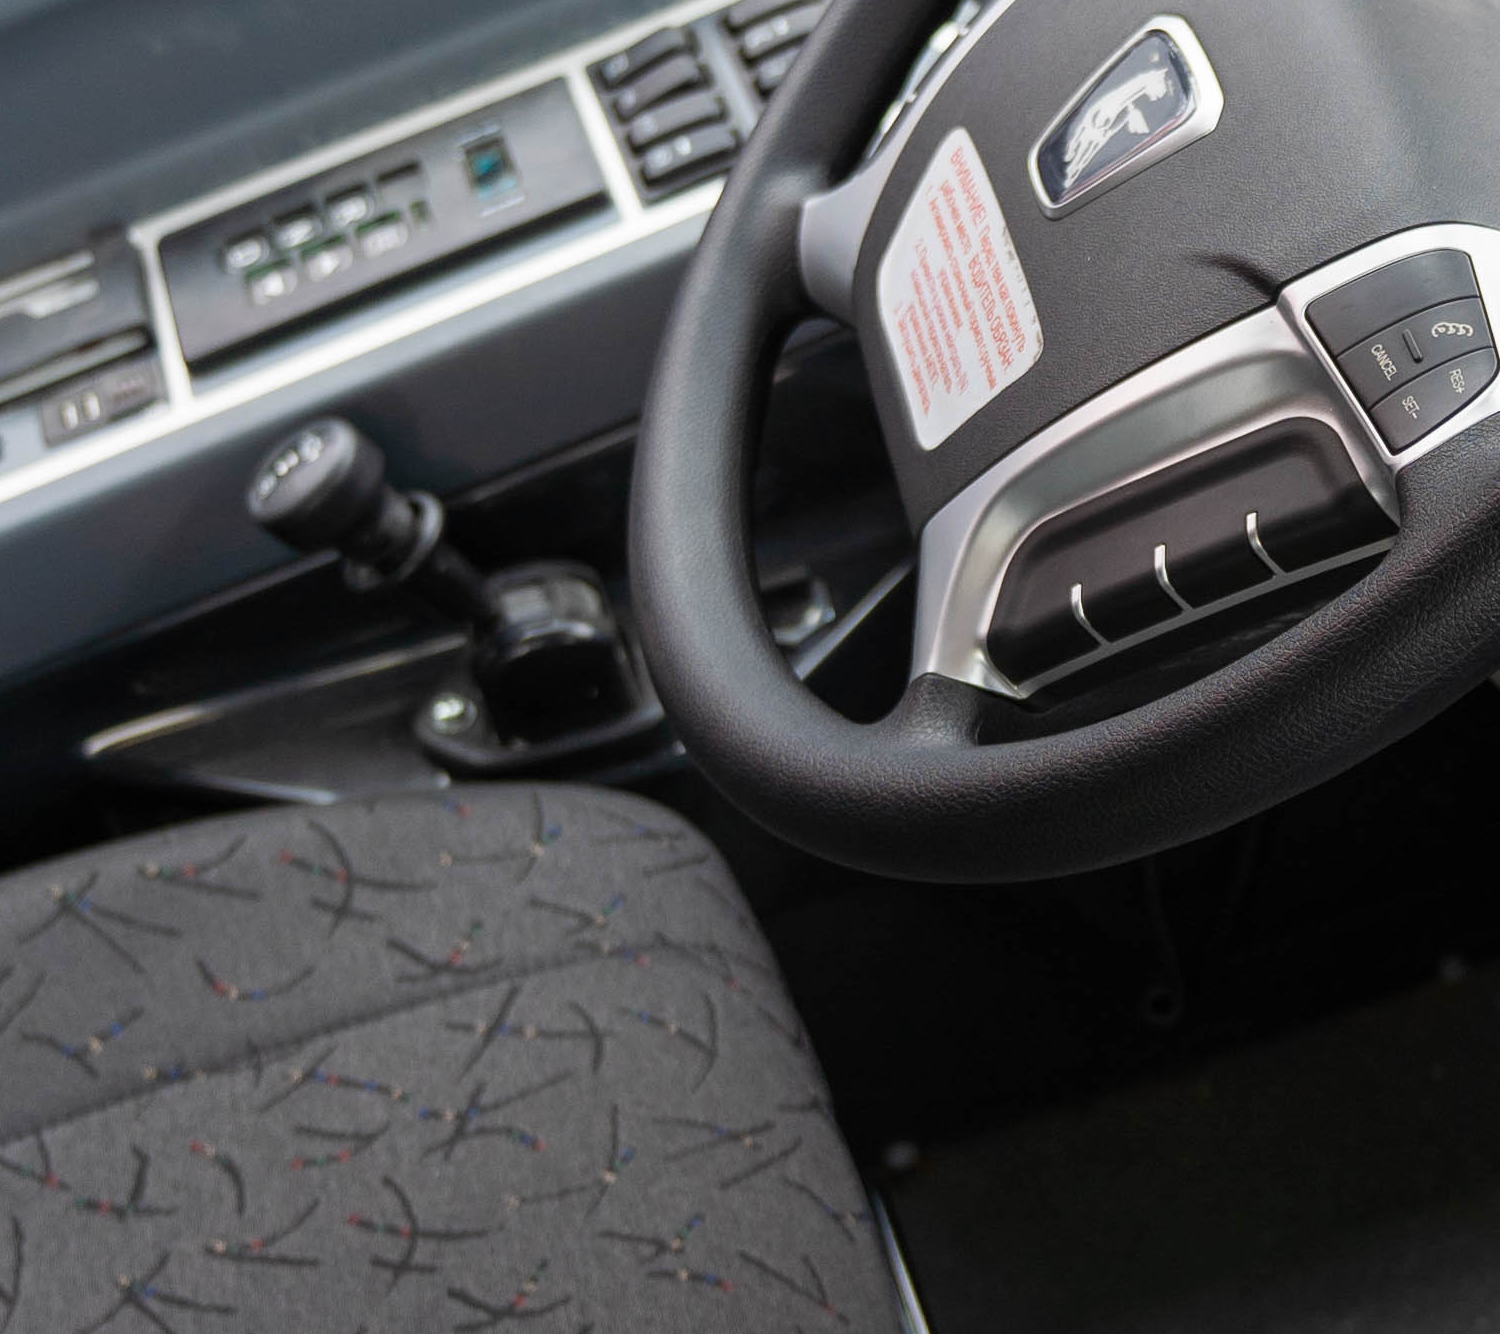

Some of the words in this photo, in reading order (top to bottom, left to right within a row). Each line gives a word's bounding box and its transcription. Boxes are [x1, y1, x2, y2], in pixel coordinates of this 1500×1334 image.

[950, 147, 986, 226] ВНИМАНИЕ!
[966, 253, 998, 323] ВОДИТЕЛЬ
[1371, 344, 1397, 381] CANCEL
[1449, 368, 1465, 394] RES+
